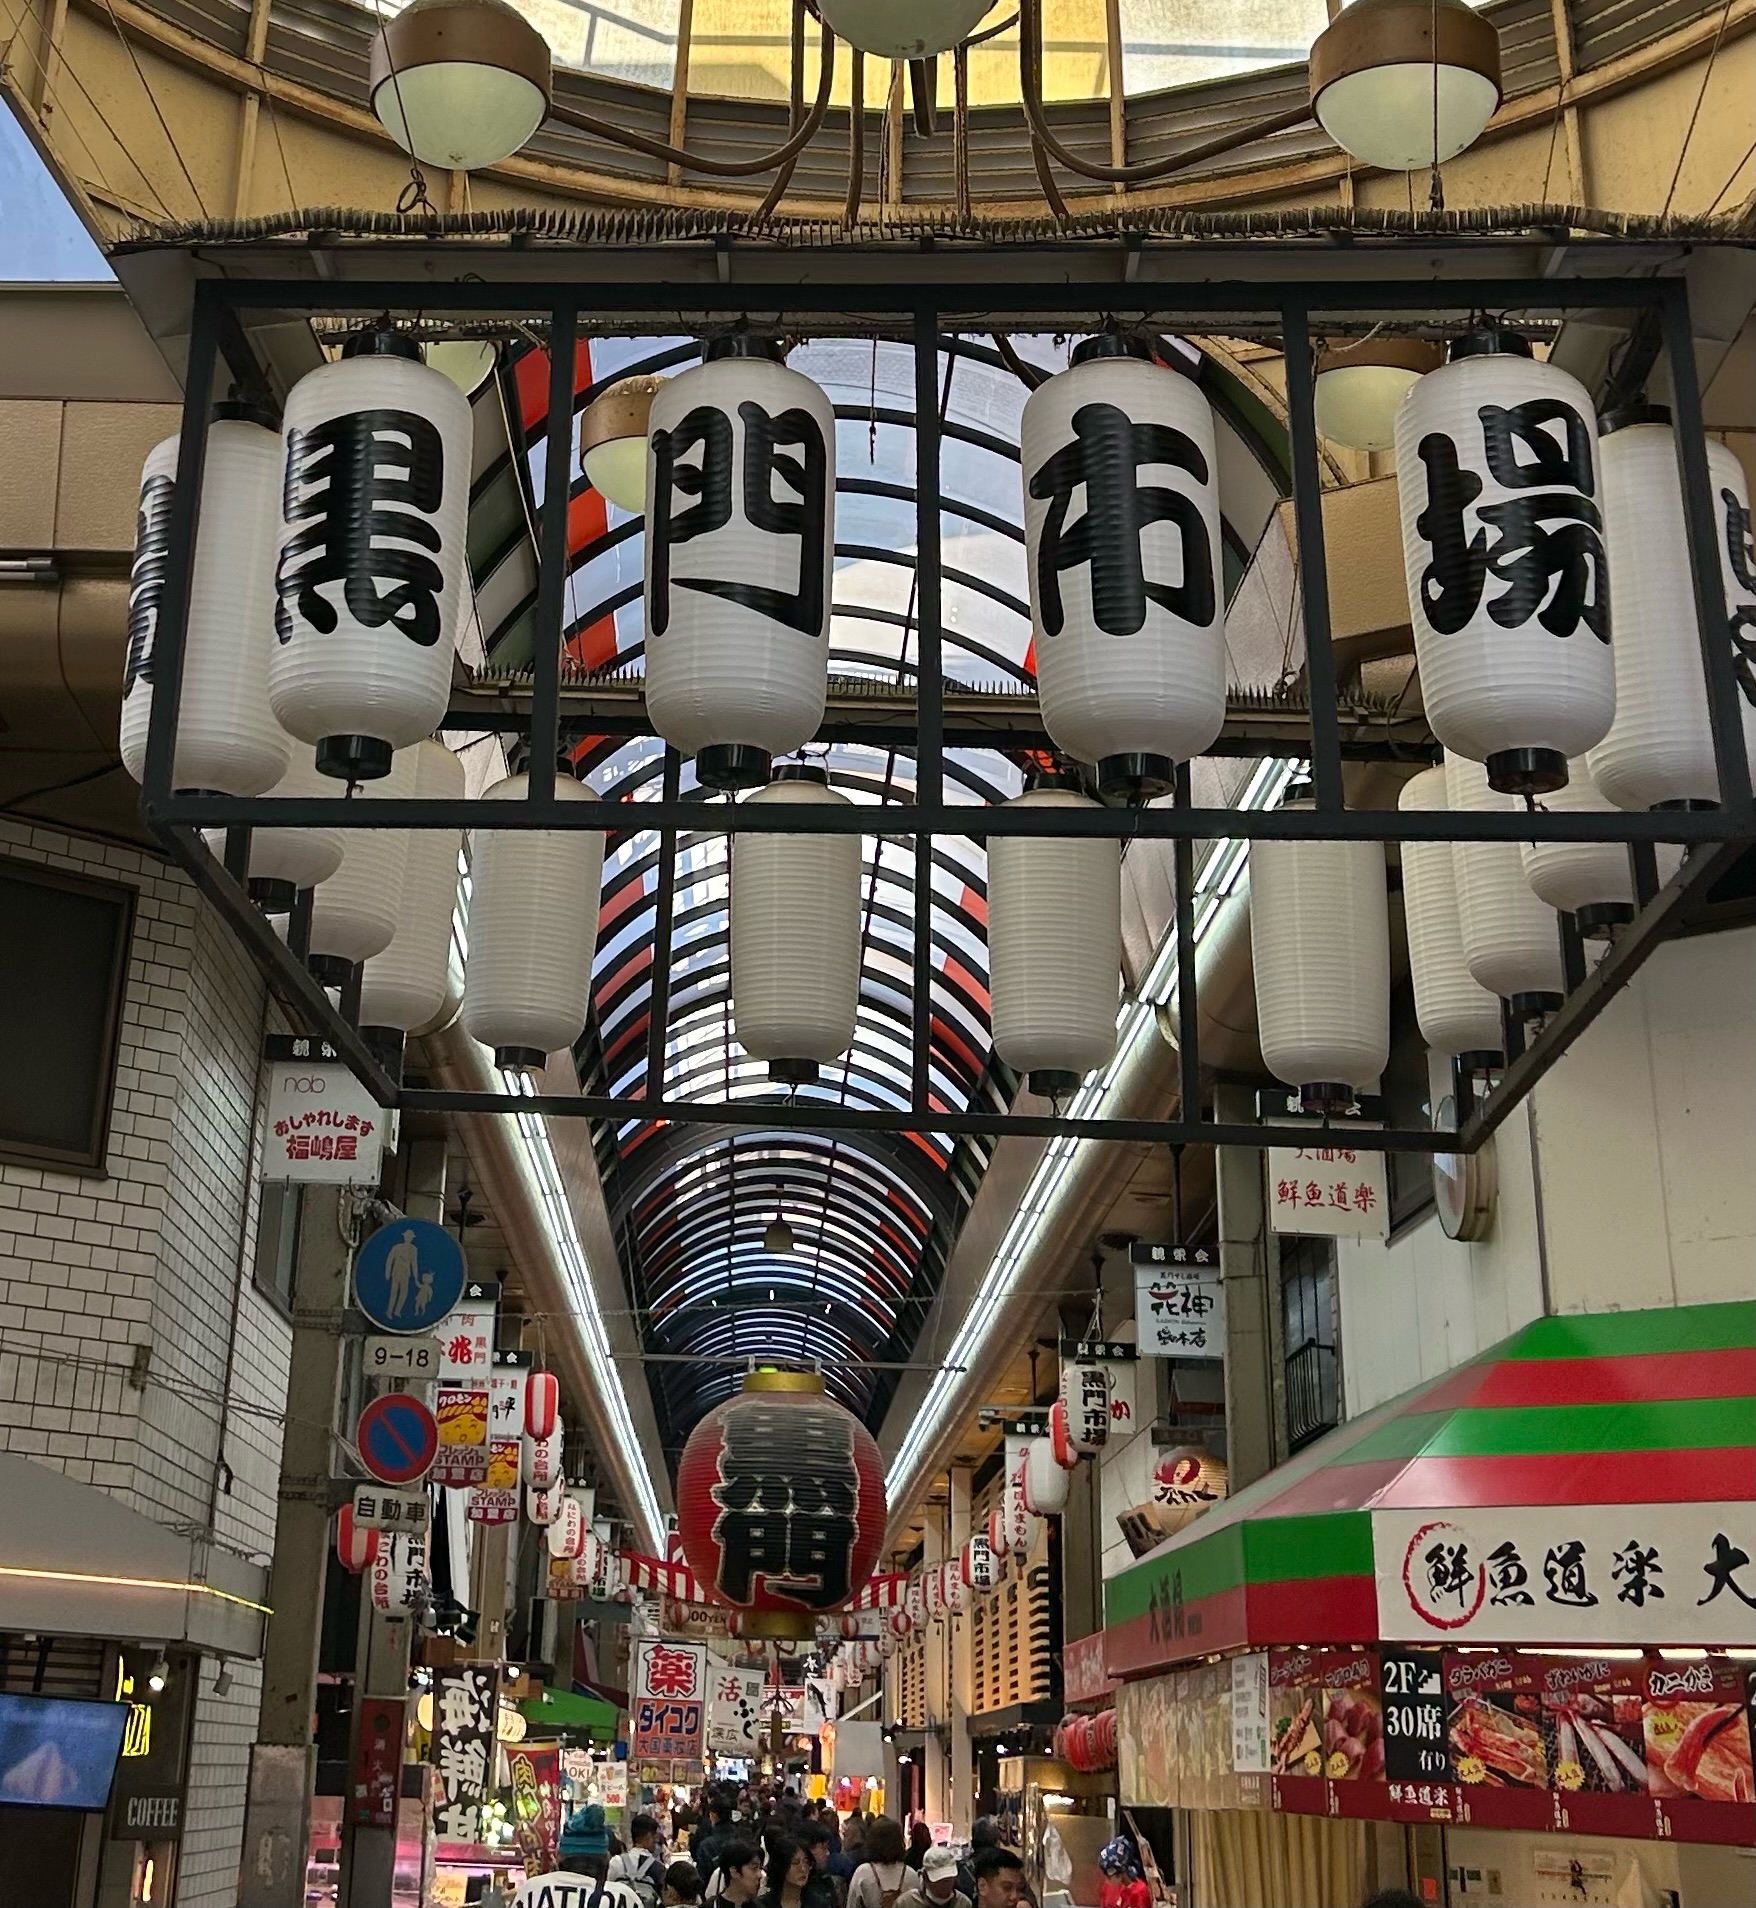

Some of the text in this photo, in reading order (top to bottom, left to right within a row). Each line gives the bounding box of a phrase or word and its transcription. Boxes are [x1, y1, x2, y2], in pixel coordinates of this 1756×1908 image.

[276, 408, 444, 647] 黒
[651, 401, 828, 638] 門
[1029, 402, 1215, 637] 市
[1416, 398, 1612, 645] 場
[273, 1110, 374, 1137] おしゃれします
[286, 1134, 358, 1160] 福嶋屋
[1277, 1179, 1377, 1213] 鮮魚道楽
[374, 1346, 430, 1368] 9-18
[1081, 1371, 1108, 1447] 黒門市場
[357, 1496, 426, 1523] 自動車
[471, 1496, 517, 1507] STAMP
[710, 1403, 860, 1609] 黒門
[973, 1538, 991, 1586] 黒門市場
[1425, 1540, 1666, 1608] 鮮魚道楽
[645, 1645, 697, 1697] 薬
[1383, 1661, 1417, 1694] 2F
[1649, 1664, 1714, 1696] カニかま
[639, 1702, 700, 1736] ダイコク
[1386, 1703, 1443, 1741] 30席
[127, 1797, 178, 1827] COFFEE
